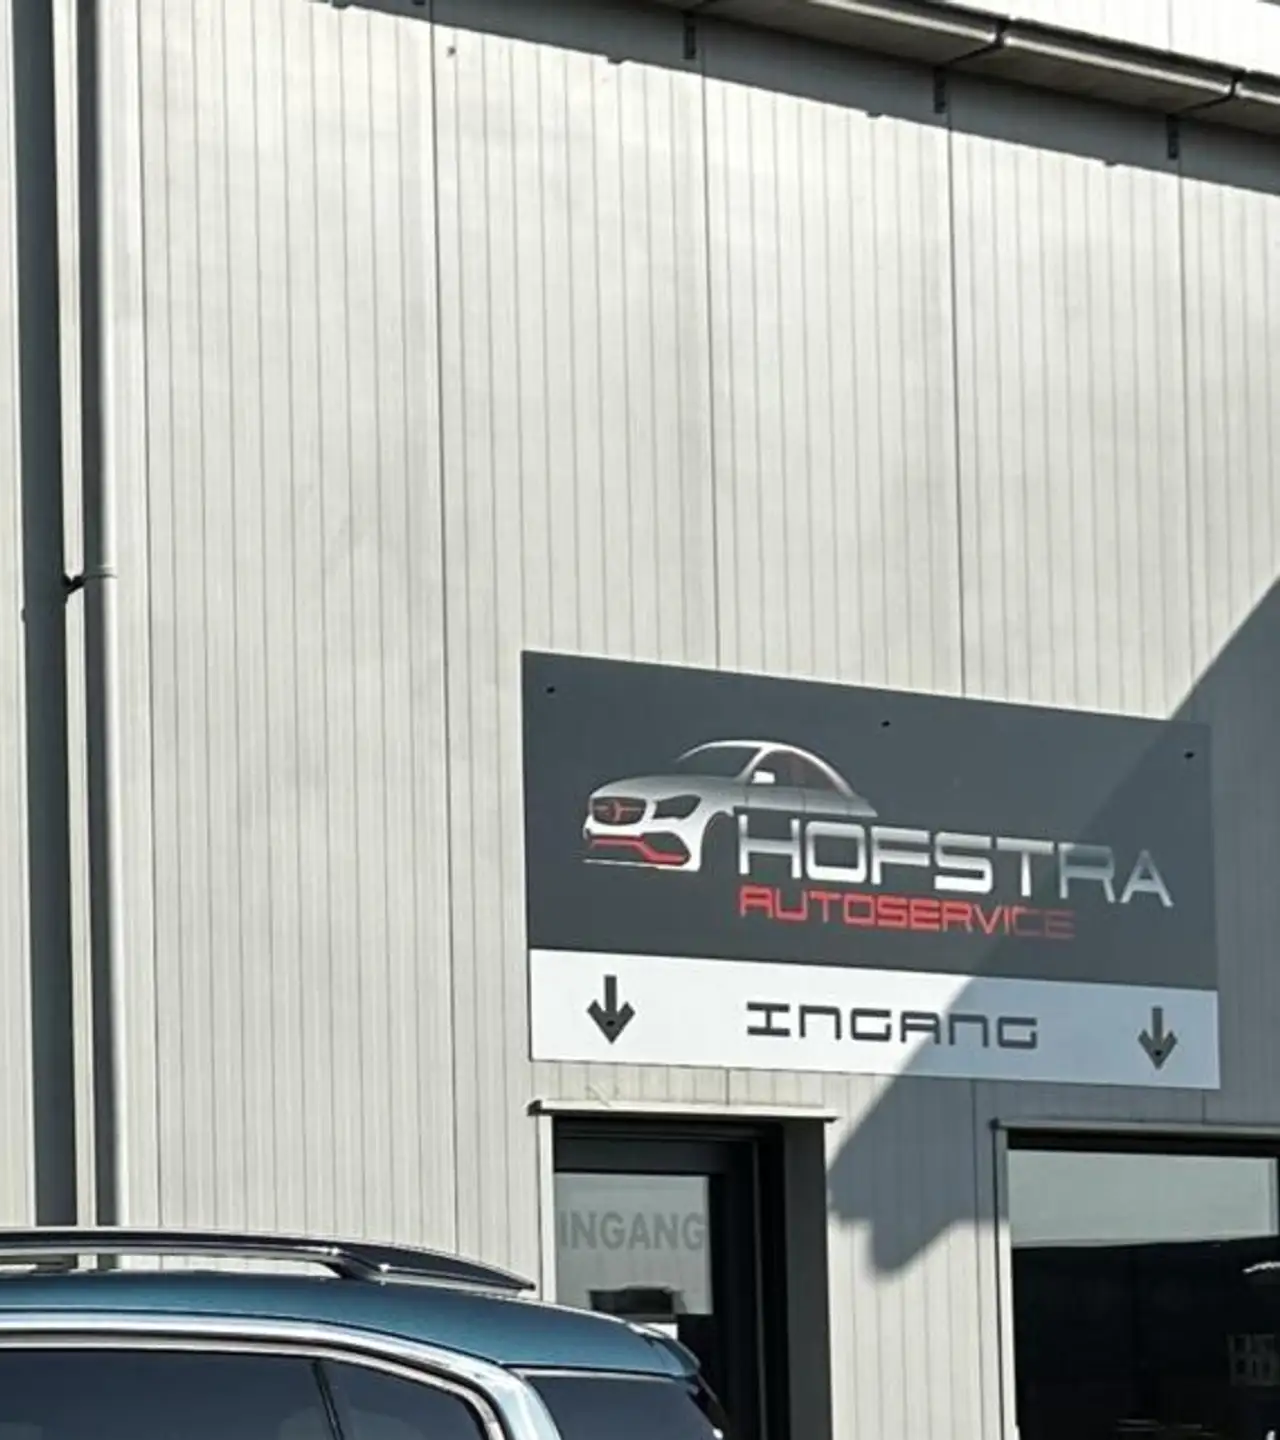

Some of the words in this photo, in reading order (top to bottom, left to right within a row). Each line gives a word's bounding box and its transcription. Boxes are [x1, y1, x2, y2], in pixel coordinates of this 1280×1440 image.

[738, 814, 1173, 908] HOFSTRA
[739, 884, 1075, 939] AUTOSERVICE
[747, 1003, 1037, 1050] INGANG
[559, 1210, 705, 1251] INGANG
